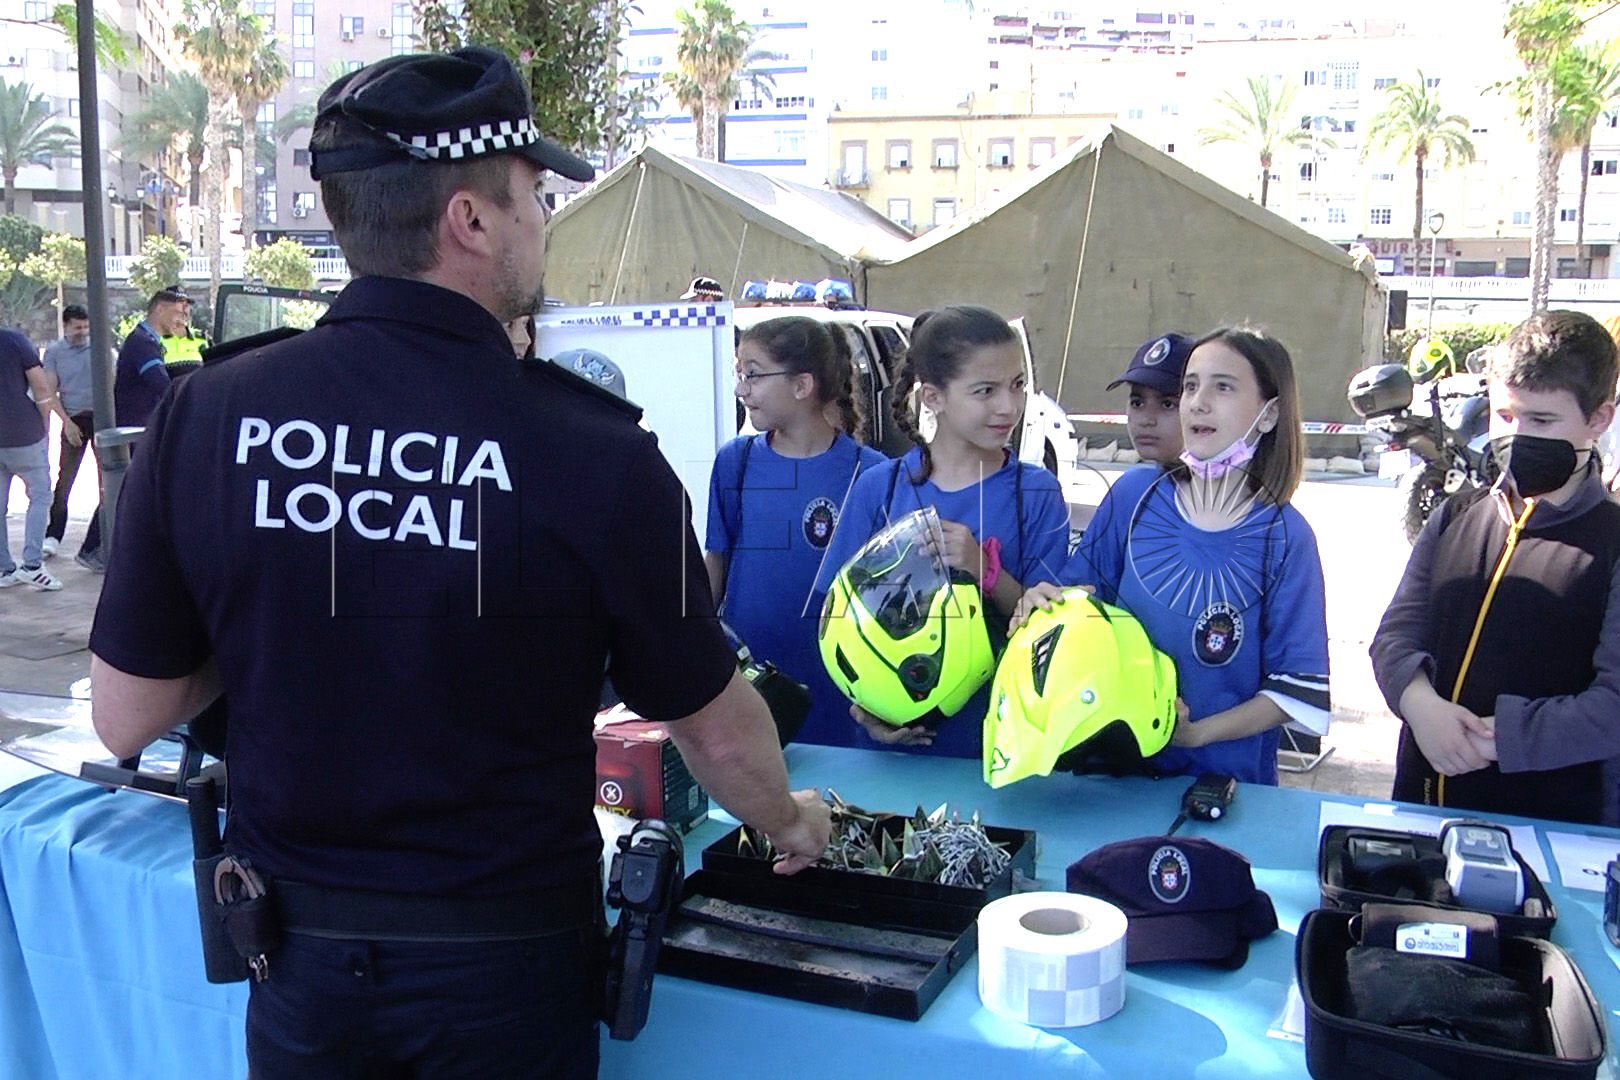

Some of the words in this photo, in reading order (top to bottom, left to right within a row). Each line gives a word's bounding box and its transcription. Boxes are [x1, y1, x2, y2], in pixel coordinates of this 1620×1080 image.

[243, 286, 268, 294] POLICIA
[235, 417, 513, 492] POLICIA
[255, 479, 477, 551] LOCAL
[1197, 606, 1230, 631] POLICIA
[1230, 613, 1242, 641] LOCAL
[1151, 850, 1171, 876] POLICIA
